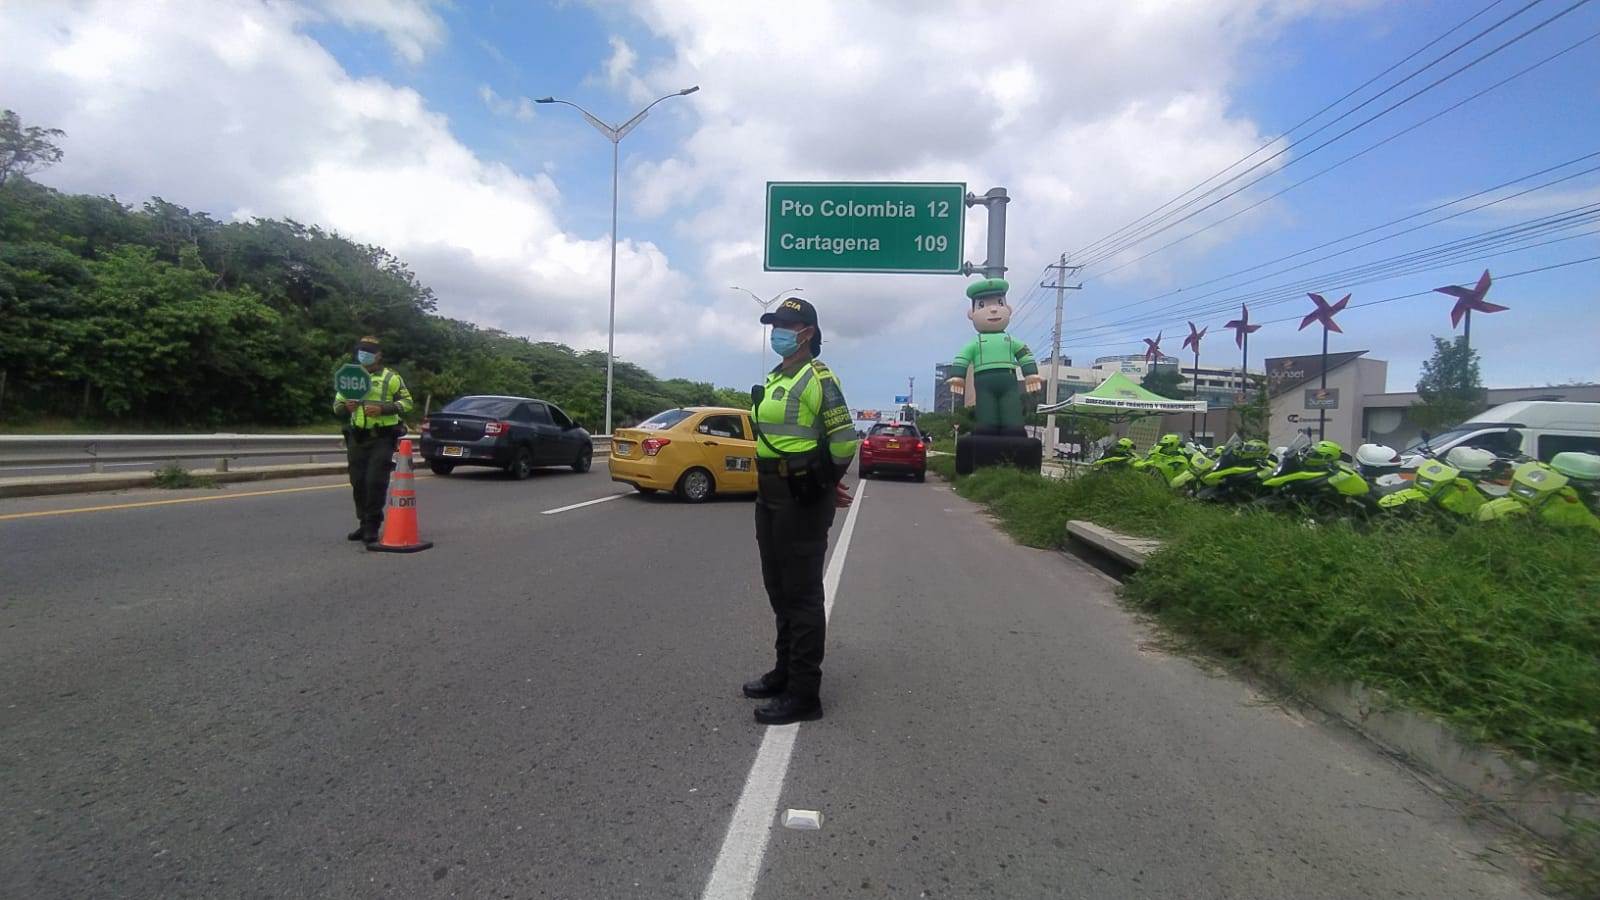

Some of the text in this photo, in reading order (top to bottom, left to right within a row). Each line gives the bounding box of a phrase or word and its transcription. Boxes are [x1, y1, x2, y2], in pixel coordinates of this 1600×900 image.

[781, 200, 949, 218] Pto Colombia 12
[780, 233, 948, 255] Cartagena 109
[340, 376, 367, 391] SIGA
[399, 497, 416, 507] DIT
